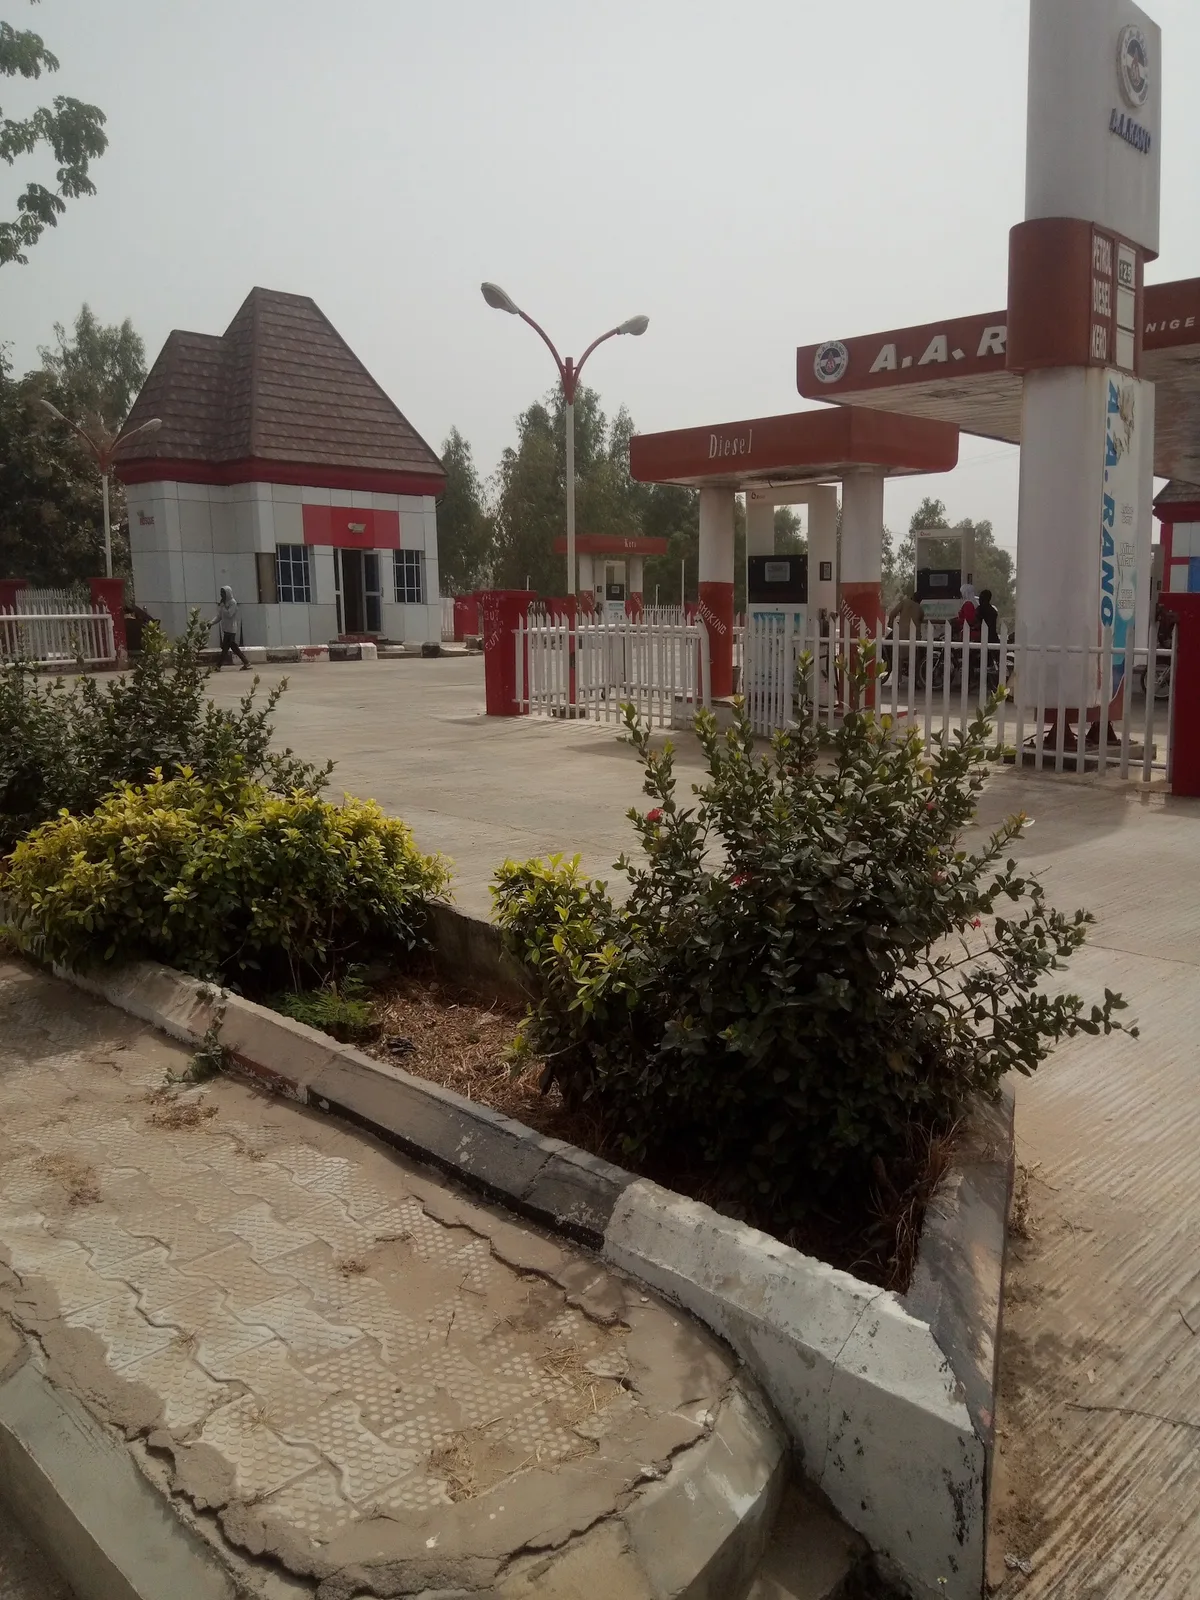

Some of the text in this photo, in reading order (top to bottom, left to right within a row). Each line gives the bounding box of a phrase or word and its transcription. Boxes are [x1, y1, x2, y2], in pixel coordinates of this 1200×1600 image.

[1093, 235, 1112, 277] PETROL
[1119, 261, 1132, 282] 125
[1093, 278, 1111, 317] DIESEL
[1091, 323, 1107, 360] KERO
[708, 429, 753, 459] Diesel
